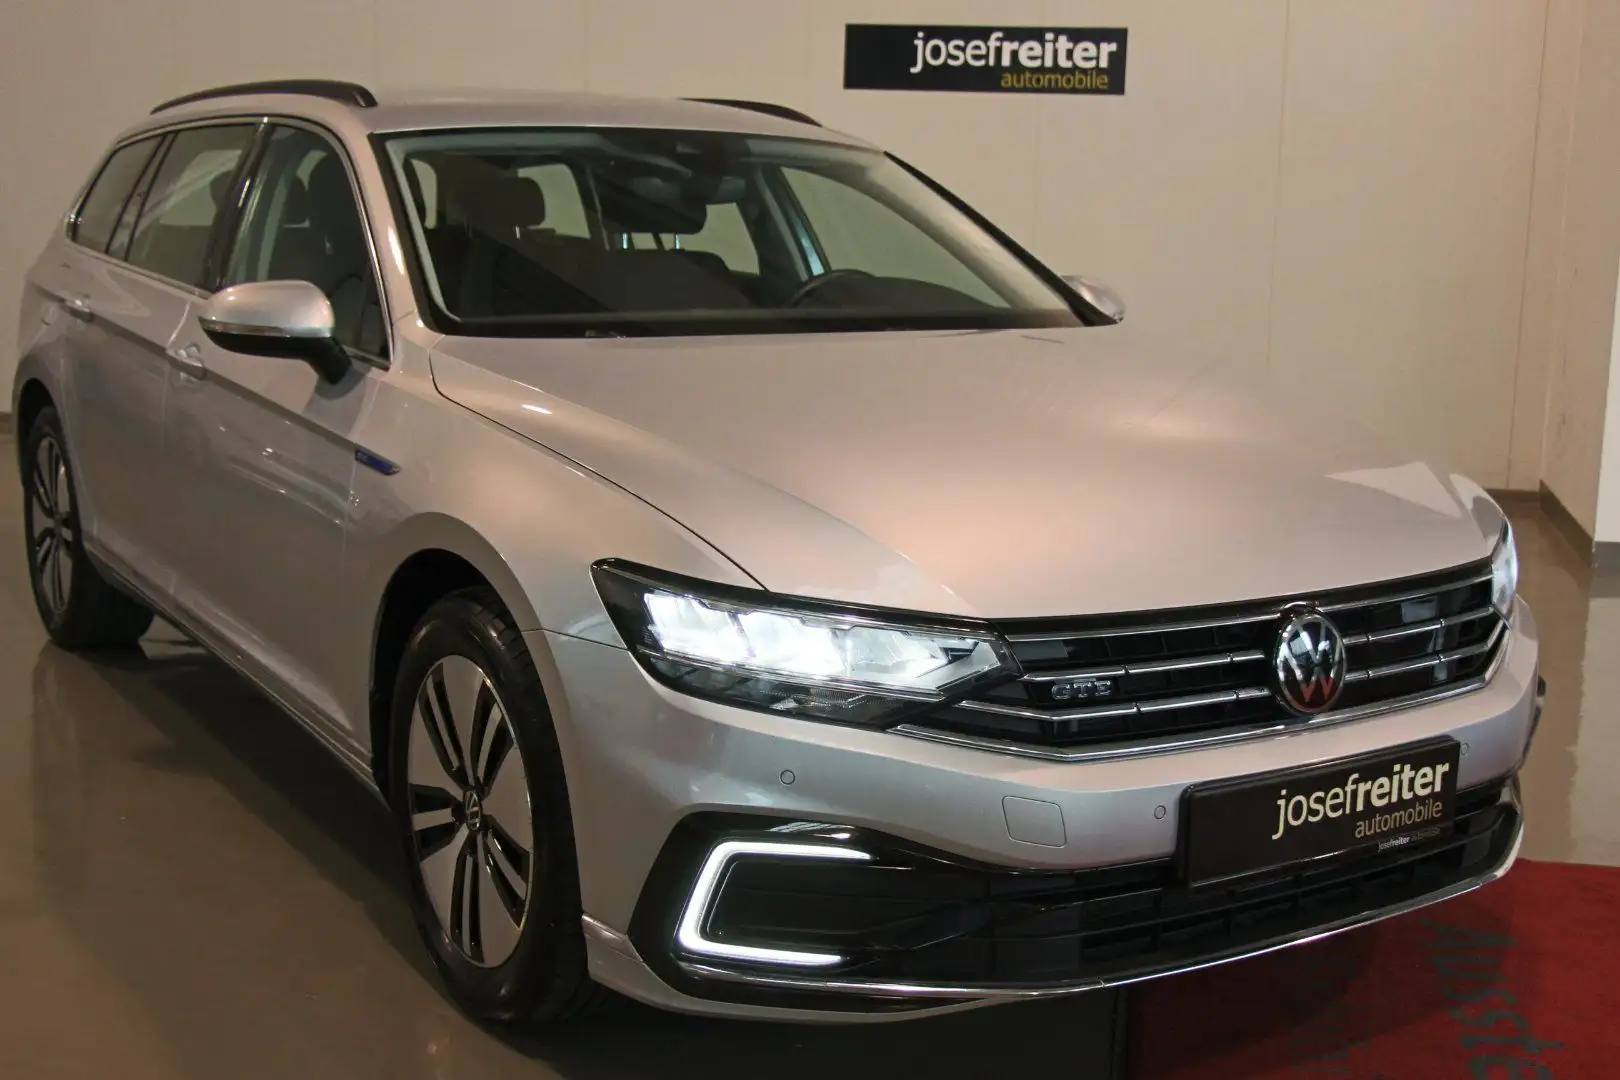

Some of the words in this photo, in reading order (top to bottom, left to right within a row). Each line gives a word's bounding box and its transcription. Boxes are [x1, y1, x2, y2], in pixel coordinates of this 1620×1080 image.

[910, 31, 1117, 73] josefreiter
[1000, 71, 1109, 89] automobile
[1051, 680, 1111, 699] GTE
[1271, 761, 1449, 840] josefreiter
[1355, 798, 1443, 838] automobile
